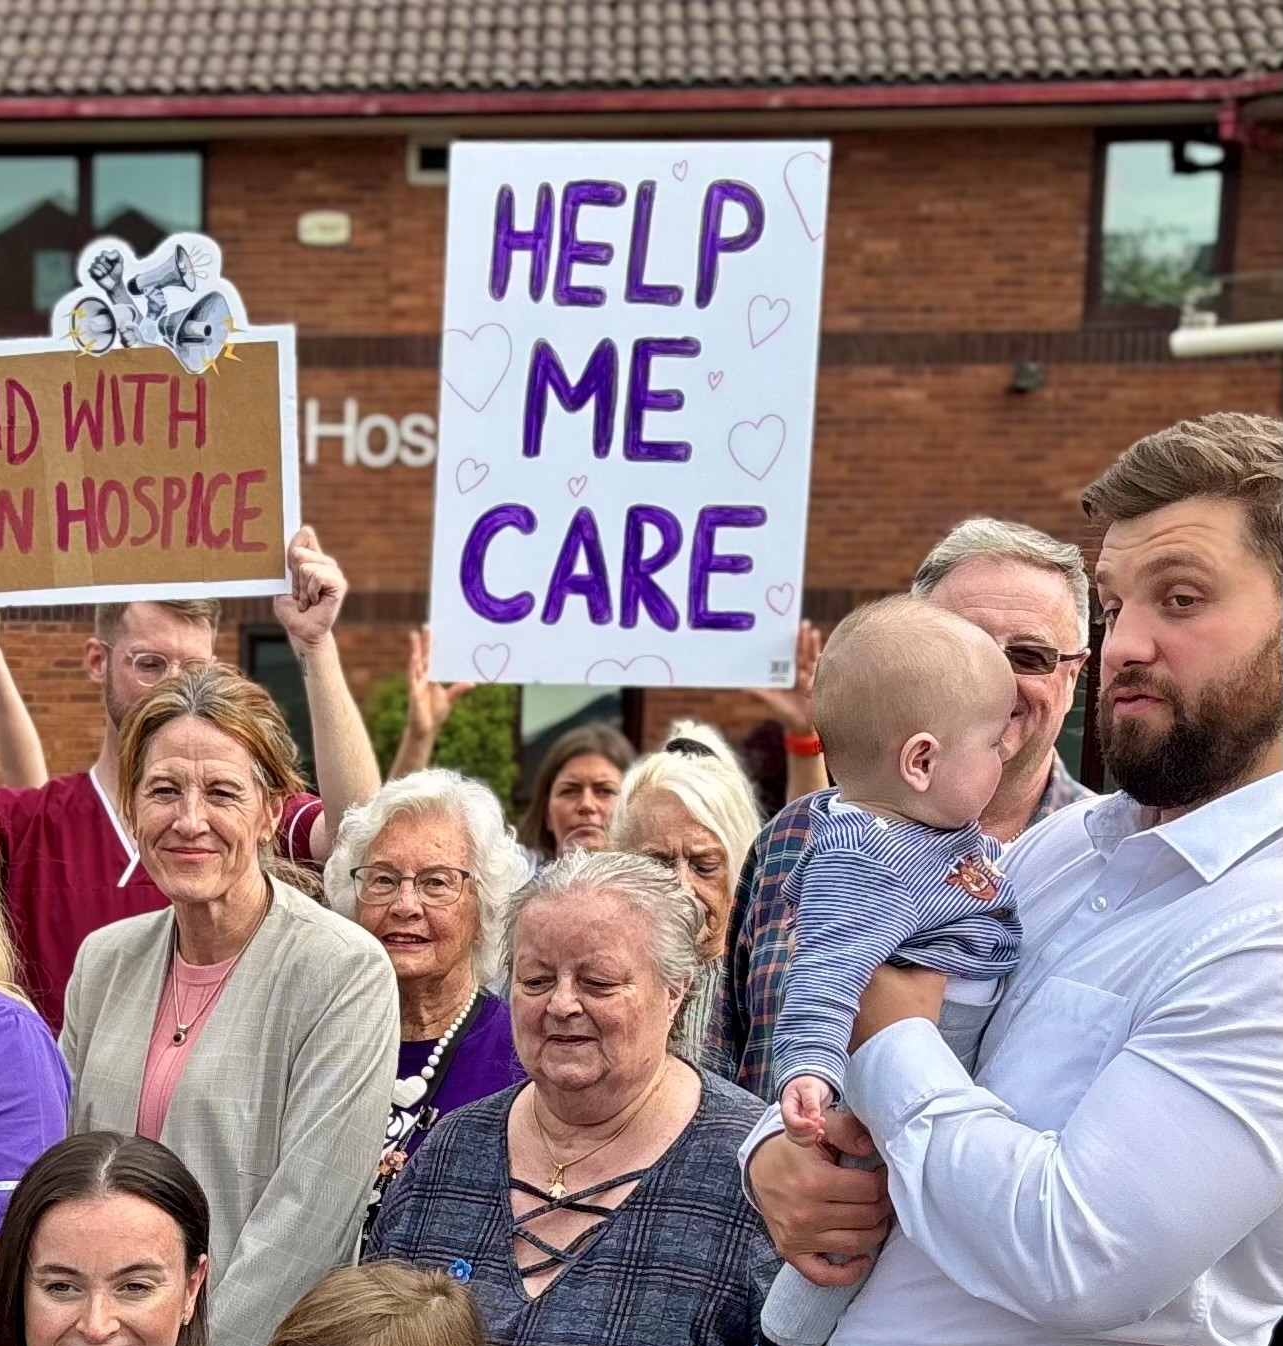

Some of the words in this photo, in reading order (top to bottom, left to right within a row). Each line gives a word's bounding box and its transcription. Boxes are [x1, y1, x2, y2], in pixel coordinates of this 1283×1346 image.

[489, 179, 765, 309] HELP
[62, 369, 207, 453] WITH
[305, 398, 436, 468] Hos
[522, 336, 701, 462] ME
[55, 469, 269, 554] HOSPICE
[460, 503, 767, 632] CARE
